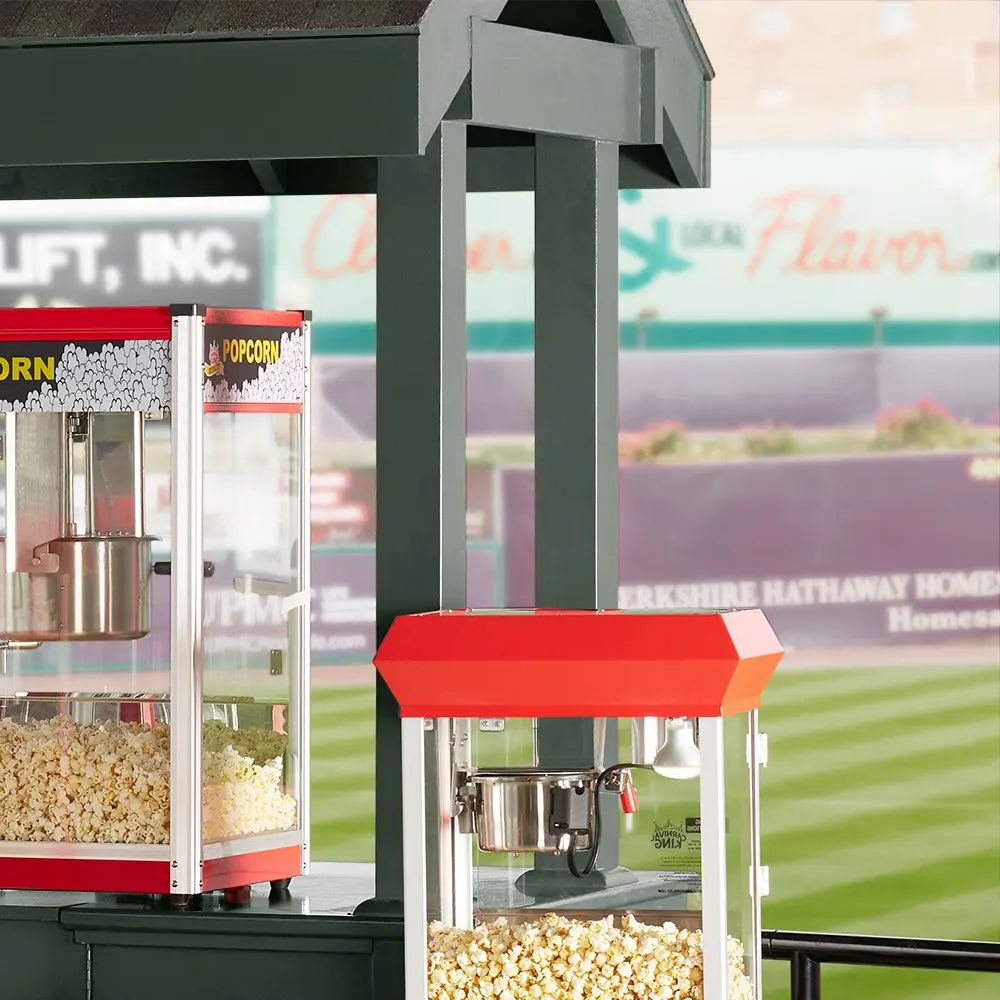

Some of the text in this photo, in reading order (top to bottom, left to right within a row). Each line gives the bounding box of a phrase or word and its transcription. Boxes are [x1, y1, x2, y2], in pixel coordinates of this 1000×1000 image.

[747, 187, 963, 279] Flavor
[139, 229, 248, 283] INC.
[223, 339, 279, 364] POPCORN
[618, 580, 758, 610] ERKSHIRE
[763, 575, 911, 606] HATHAWAY
